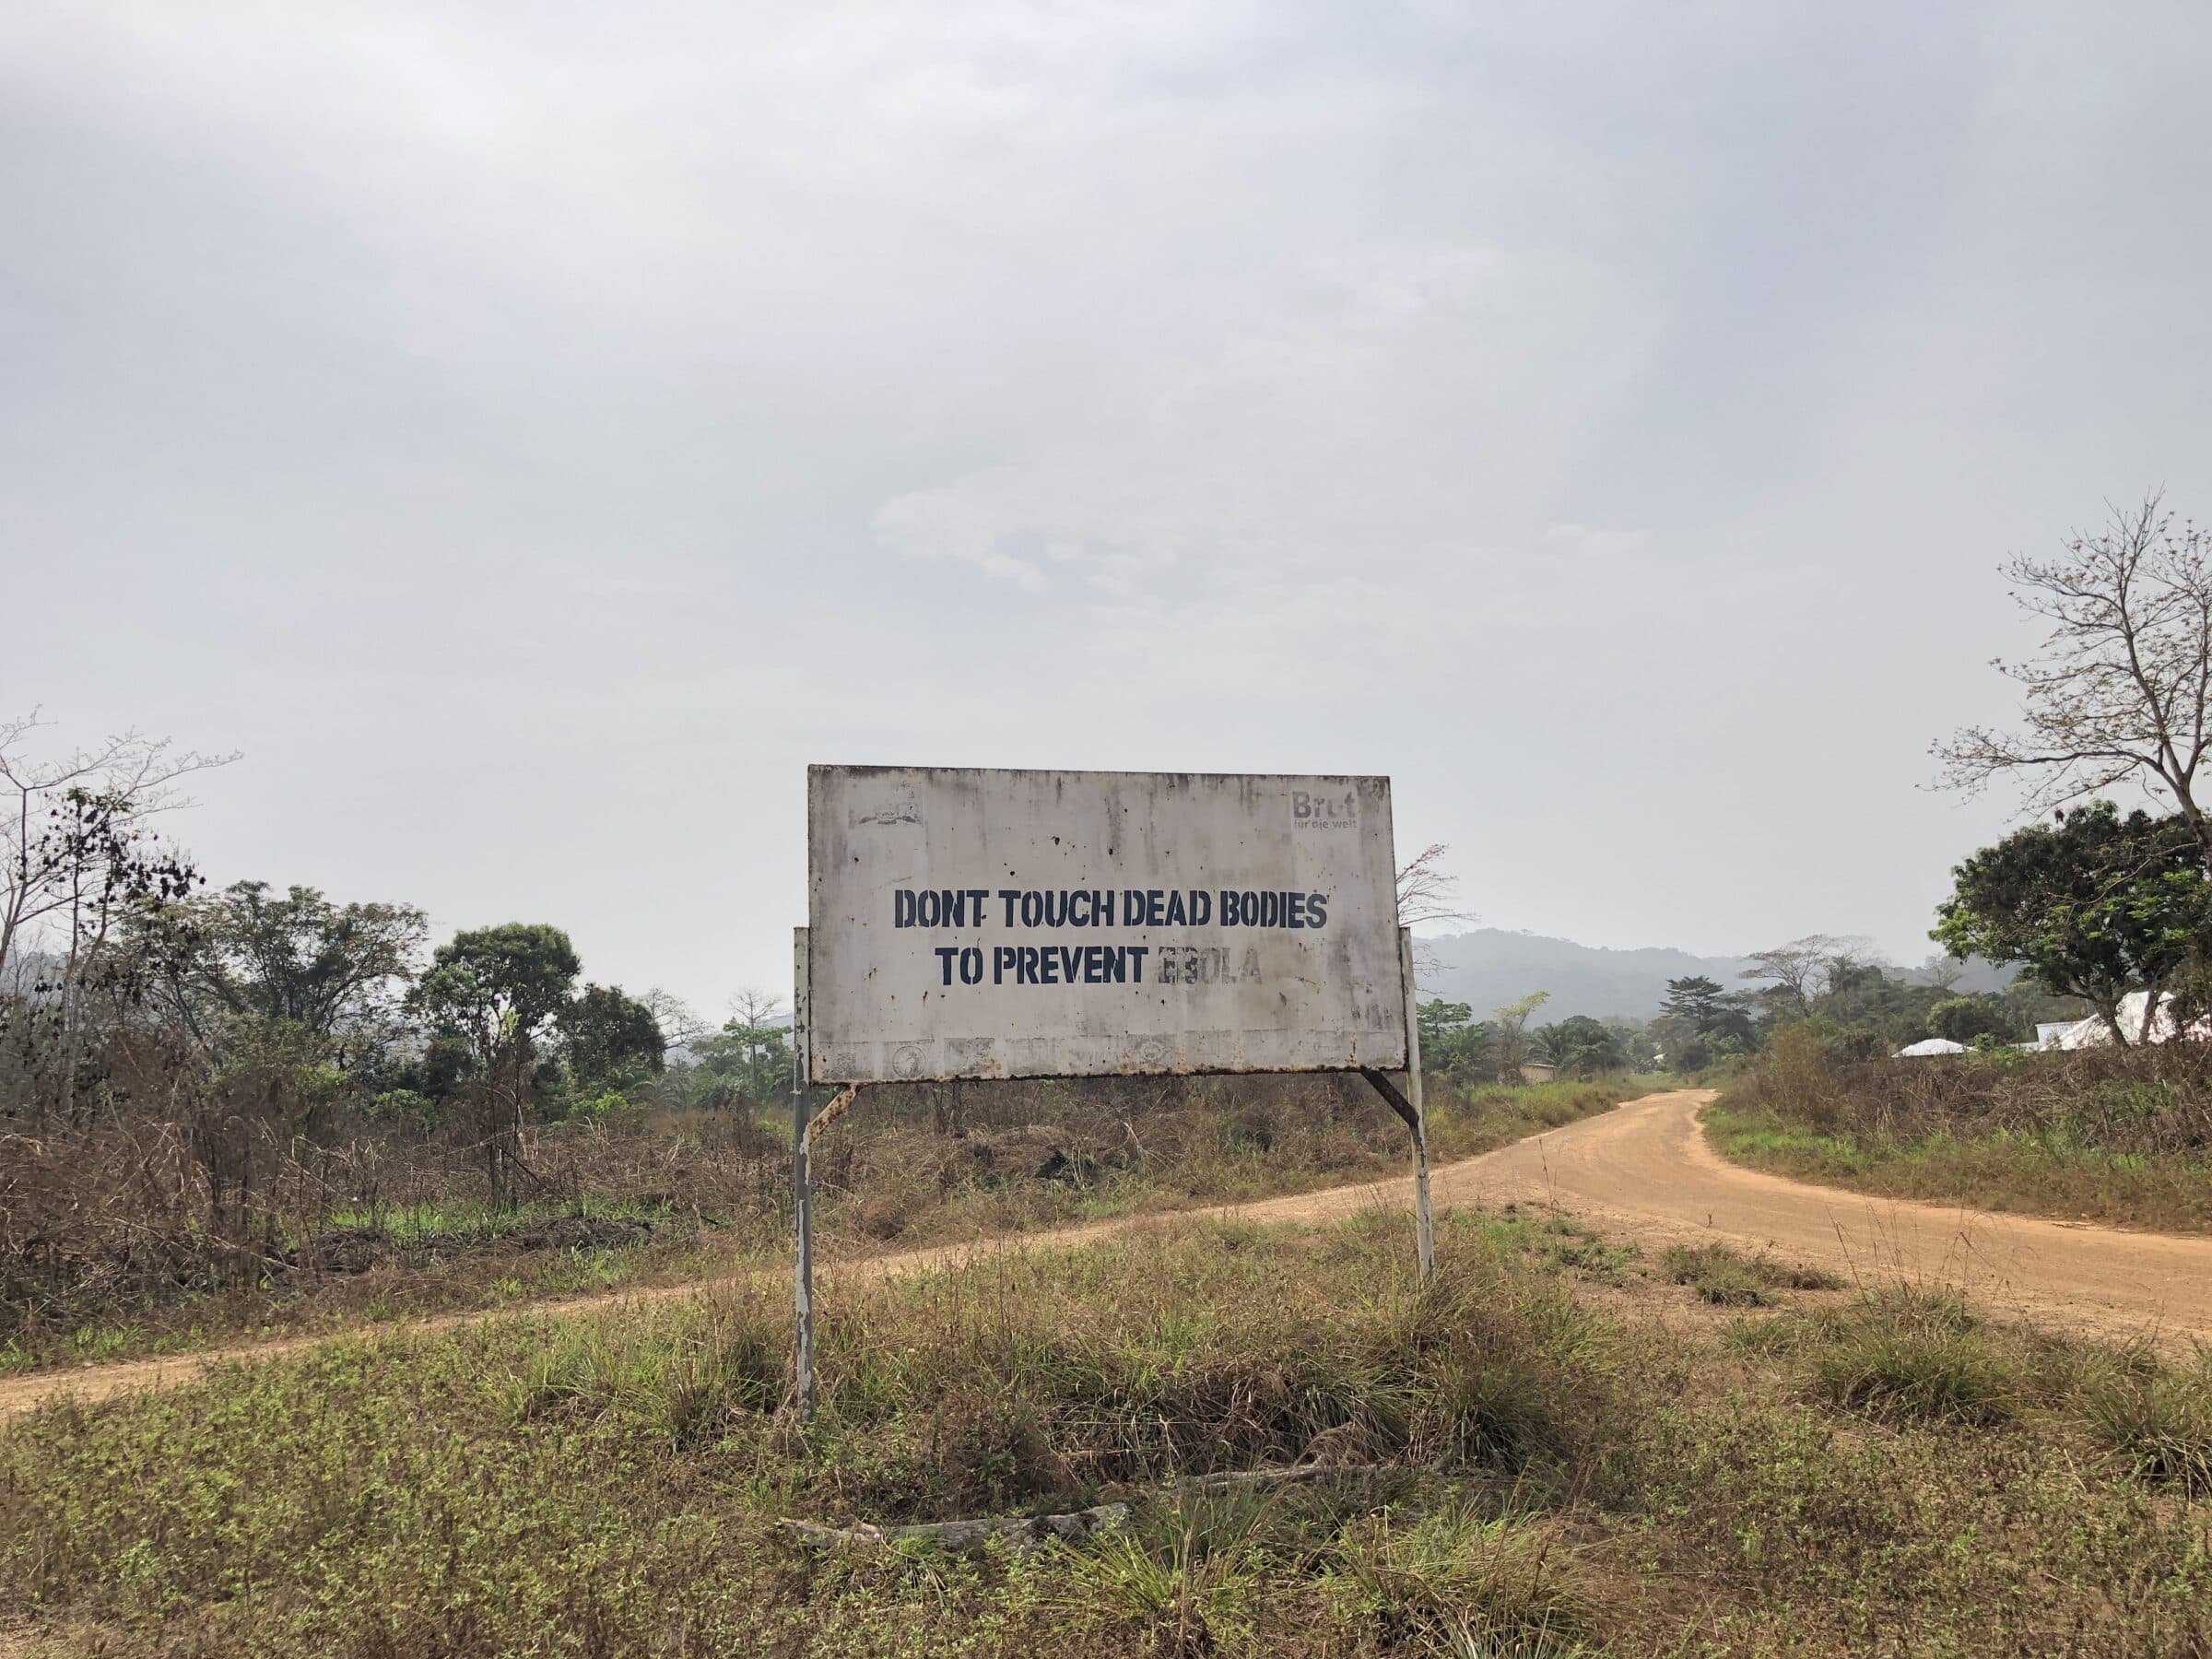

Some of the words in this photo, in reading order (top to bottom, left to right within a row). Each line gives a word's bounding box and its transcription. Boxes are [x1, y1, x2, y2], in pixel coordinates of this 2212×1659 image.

[895, 889, 989, 928] DONT
[998, 889, 1114, 927] TOUCH
[1124, 889, 1211, 926] DEAD
[1220, 890, 1327, 929] BODIES
[935, 947, 983, 985] TO
[994, 946, 1148, 984] PREVENT
[1159, 946, 1262, 984] EBOLA
